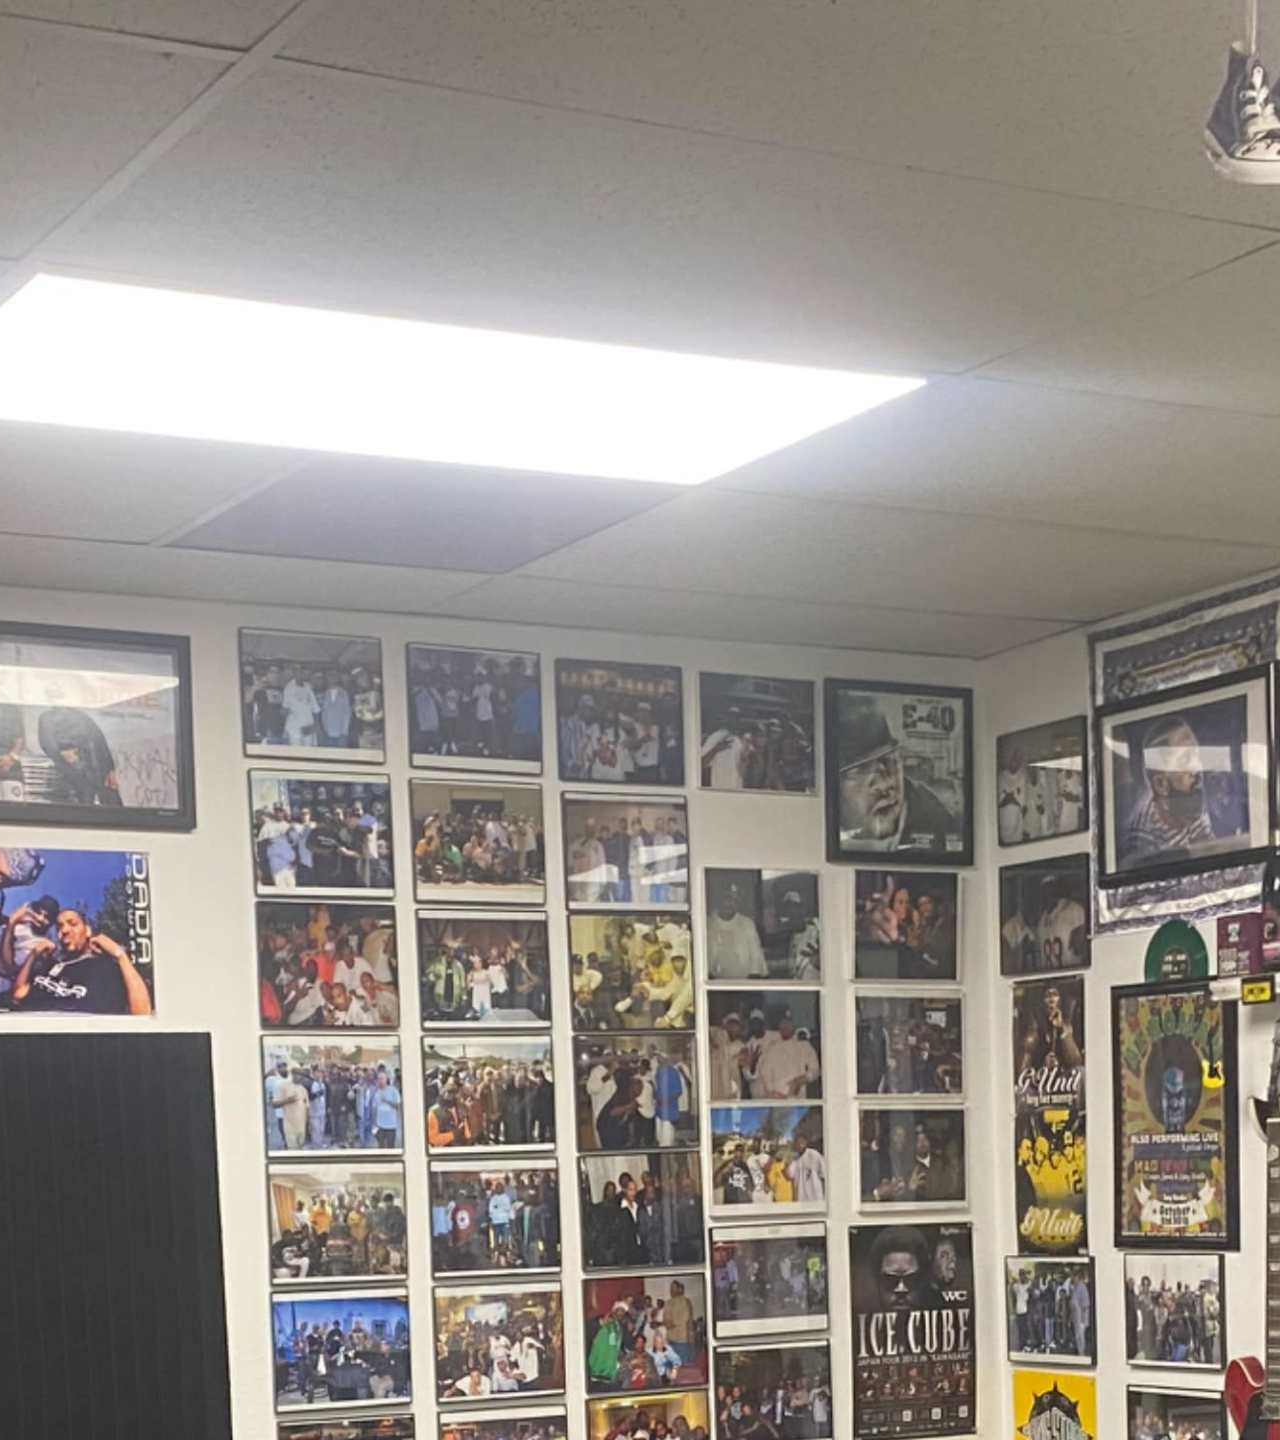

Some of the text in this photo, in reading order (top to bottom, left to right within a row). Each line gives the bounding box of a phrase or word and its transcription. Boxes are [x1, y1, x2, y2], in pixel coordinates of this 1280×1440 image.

[901, 703, 954, 733] E-40
[131, 854, 152, 964] DADA
[941, 1290, 969, 1302] WC
[907, 1307, 970, 1354] CUBE
